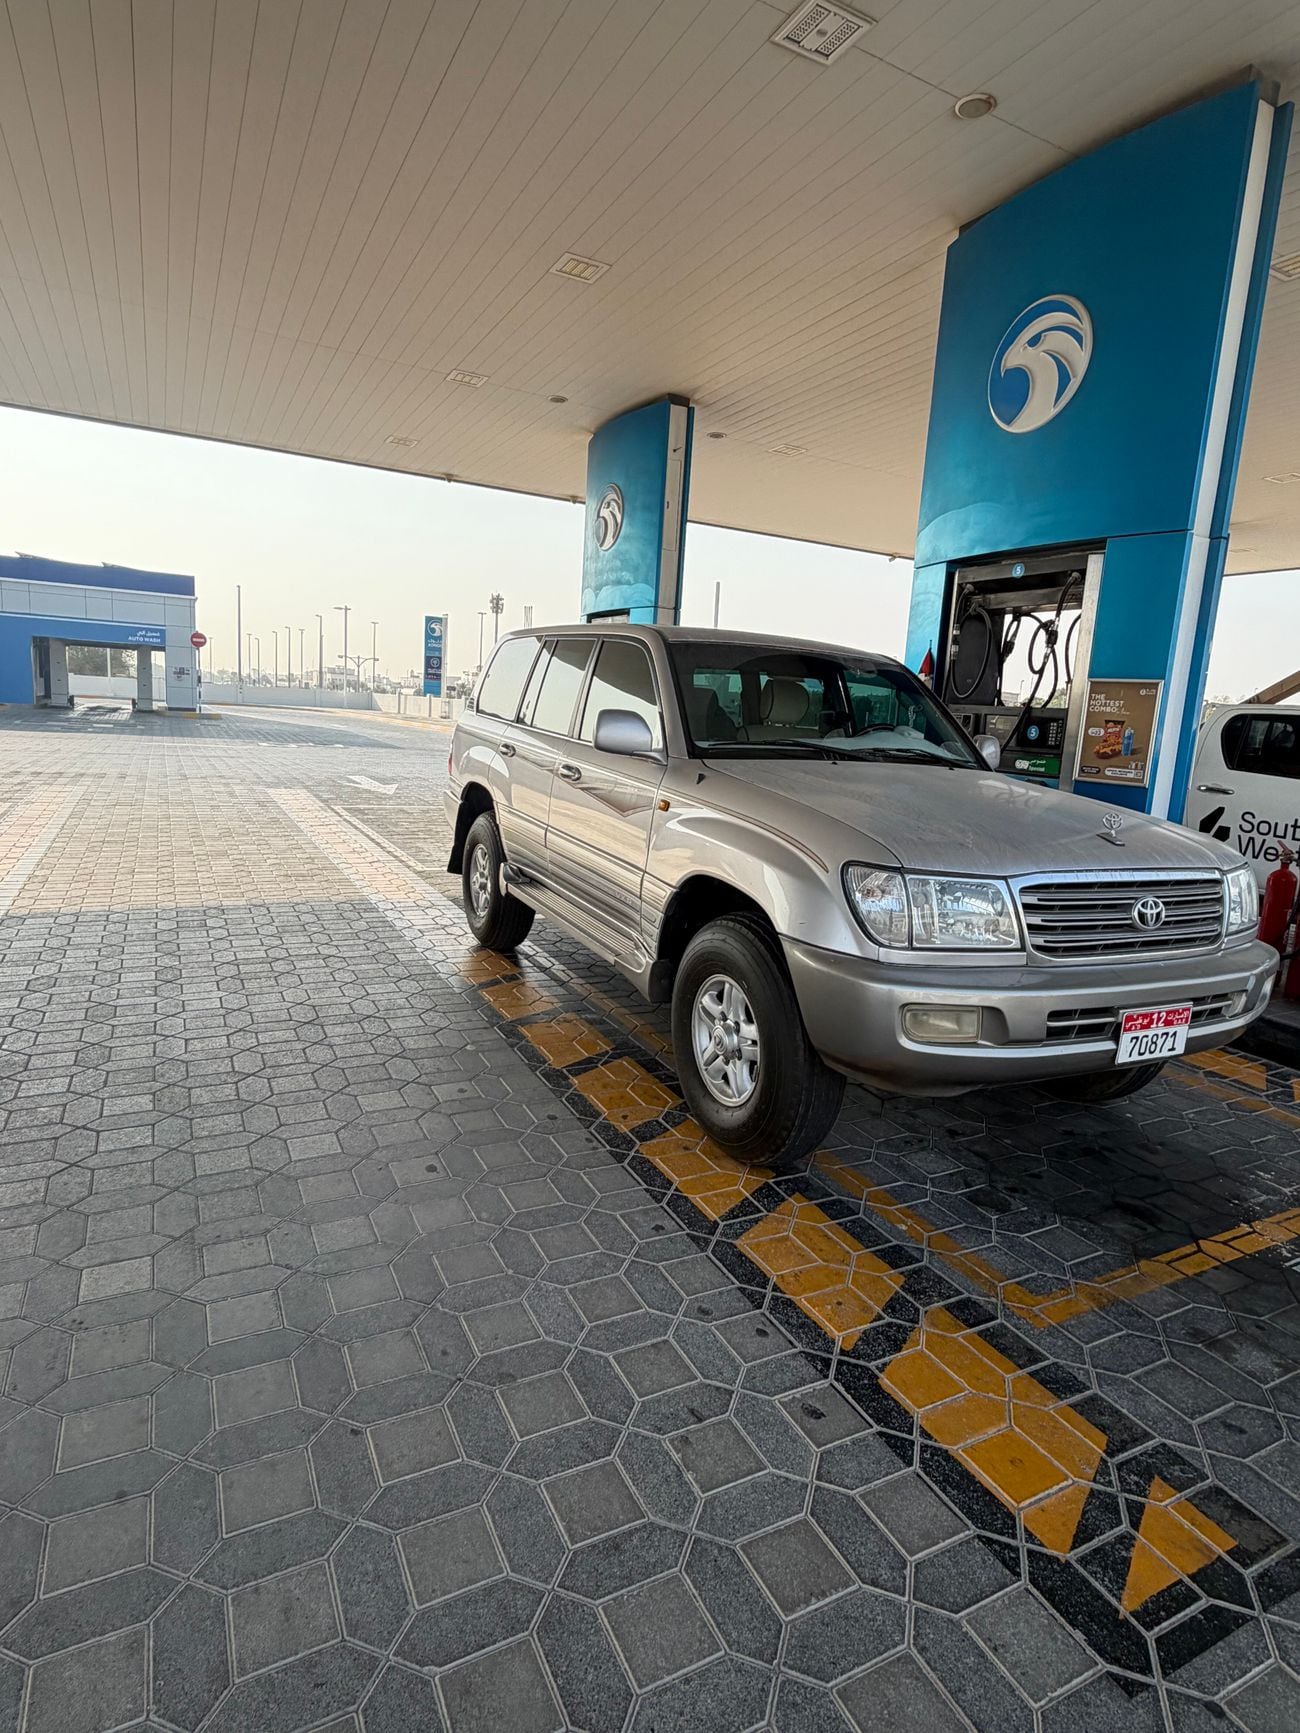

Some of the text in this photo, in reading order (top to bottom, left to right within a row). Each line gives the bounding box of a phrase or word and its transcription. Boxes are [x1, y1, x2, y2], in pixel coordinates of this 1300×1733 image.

[1089, 705, 1117, 713] COMBO
[1030, 728, 1036, 737] 5
[1237, 834, 1300, 863] Wet
[1150, 1012, 1167, 1028] 12
[1128, 1031, 1177, 1058] 70871
